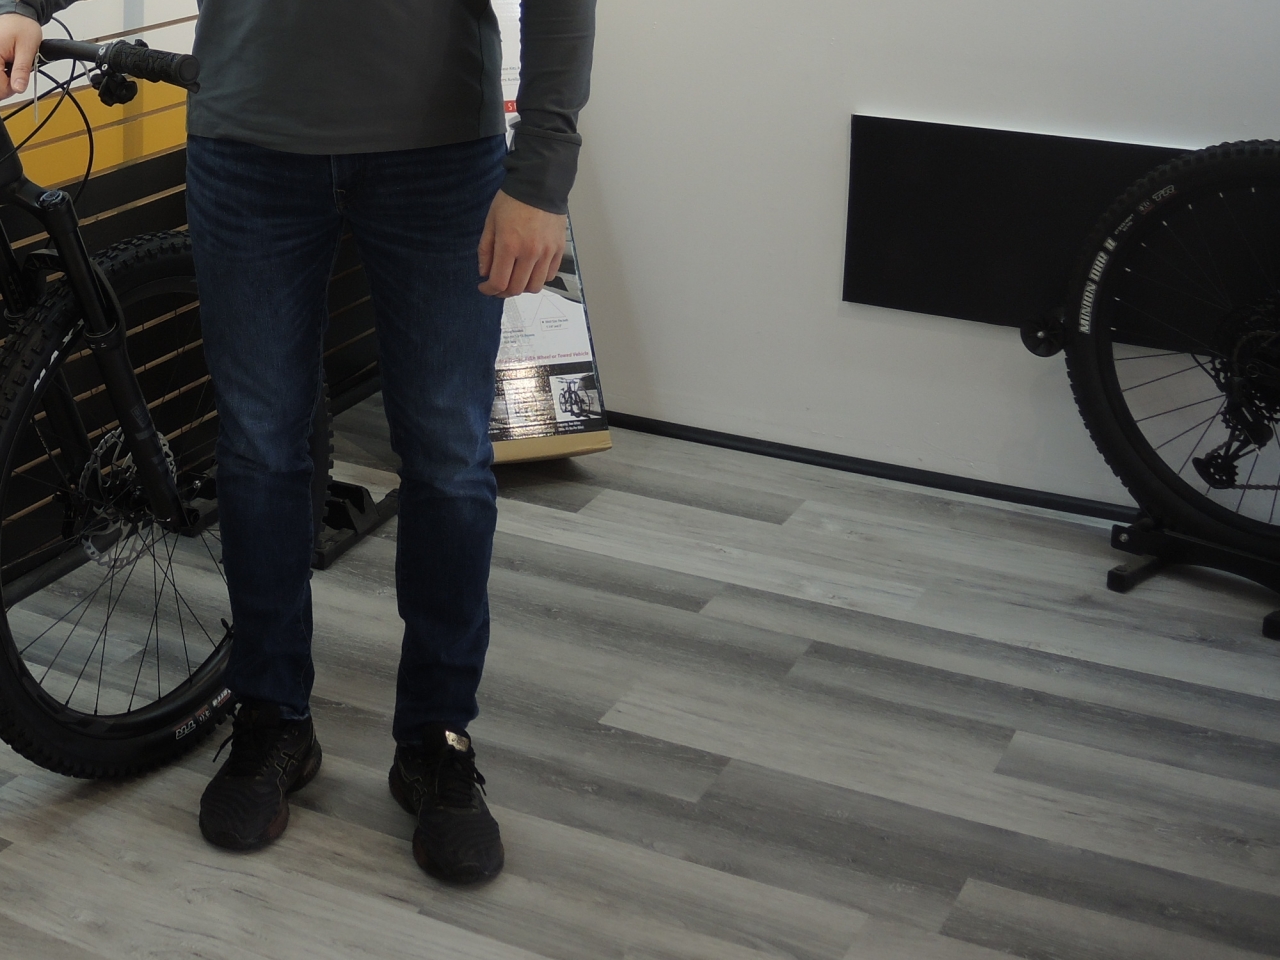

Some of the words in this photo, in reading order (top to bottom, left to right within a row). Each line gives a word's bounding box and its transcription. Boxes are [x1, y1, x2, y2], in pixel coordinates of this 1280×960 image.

[1152, 184, 1175, 202] TR
[1078, 280, 1098, 334] MINION
[34, 318, 84, 392] MAX
[198, 710, 210, 722] EXO
[176, 720, 197, 740] TR
